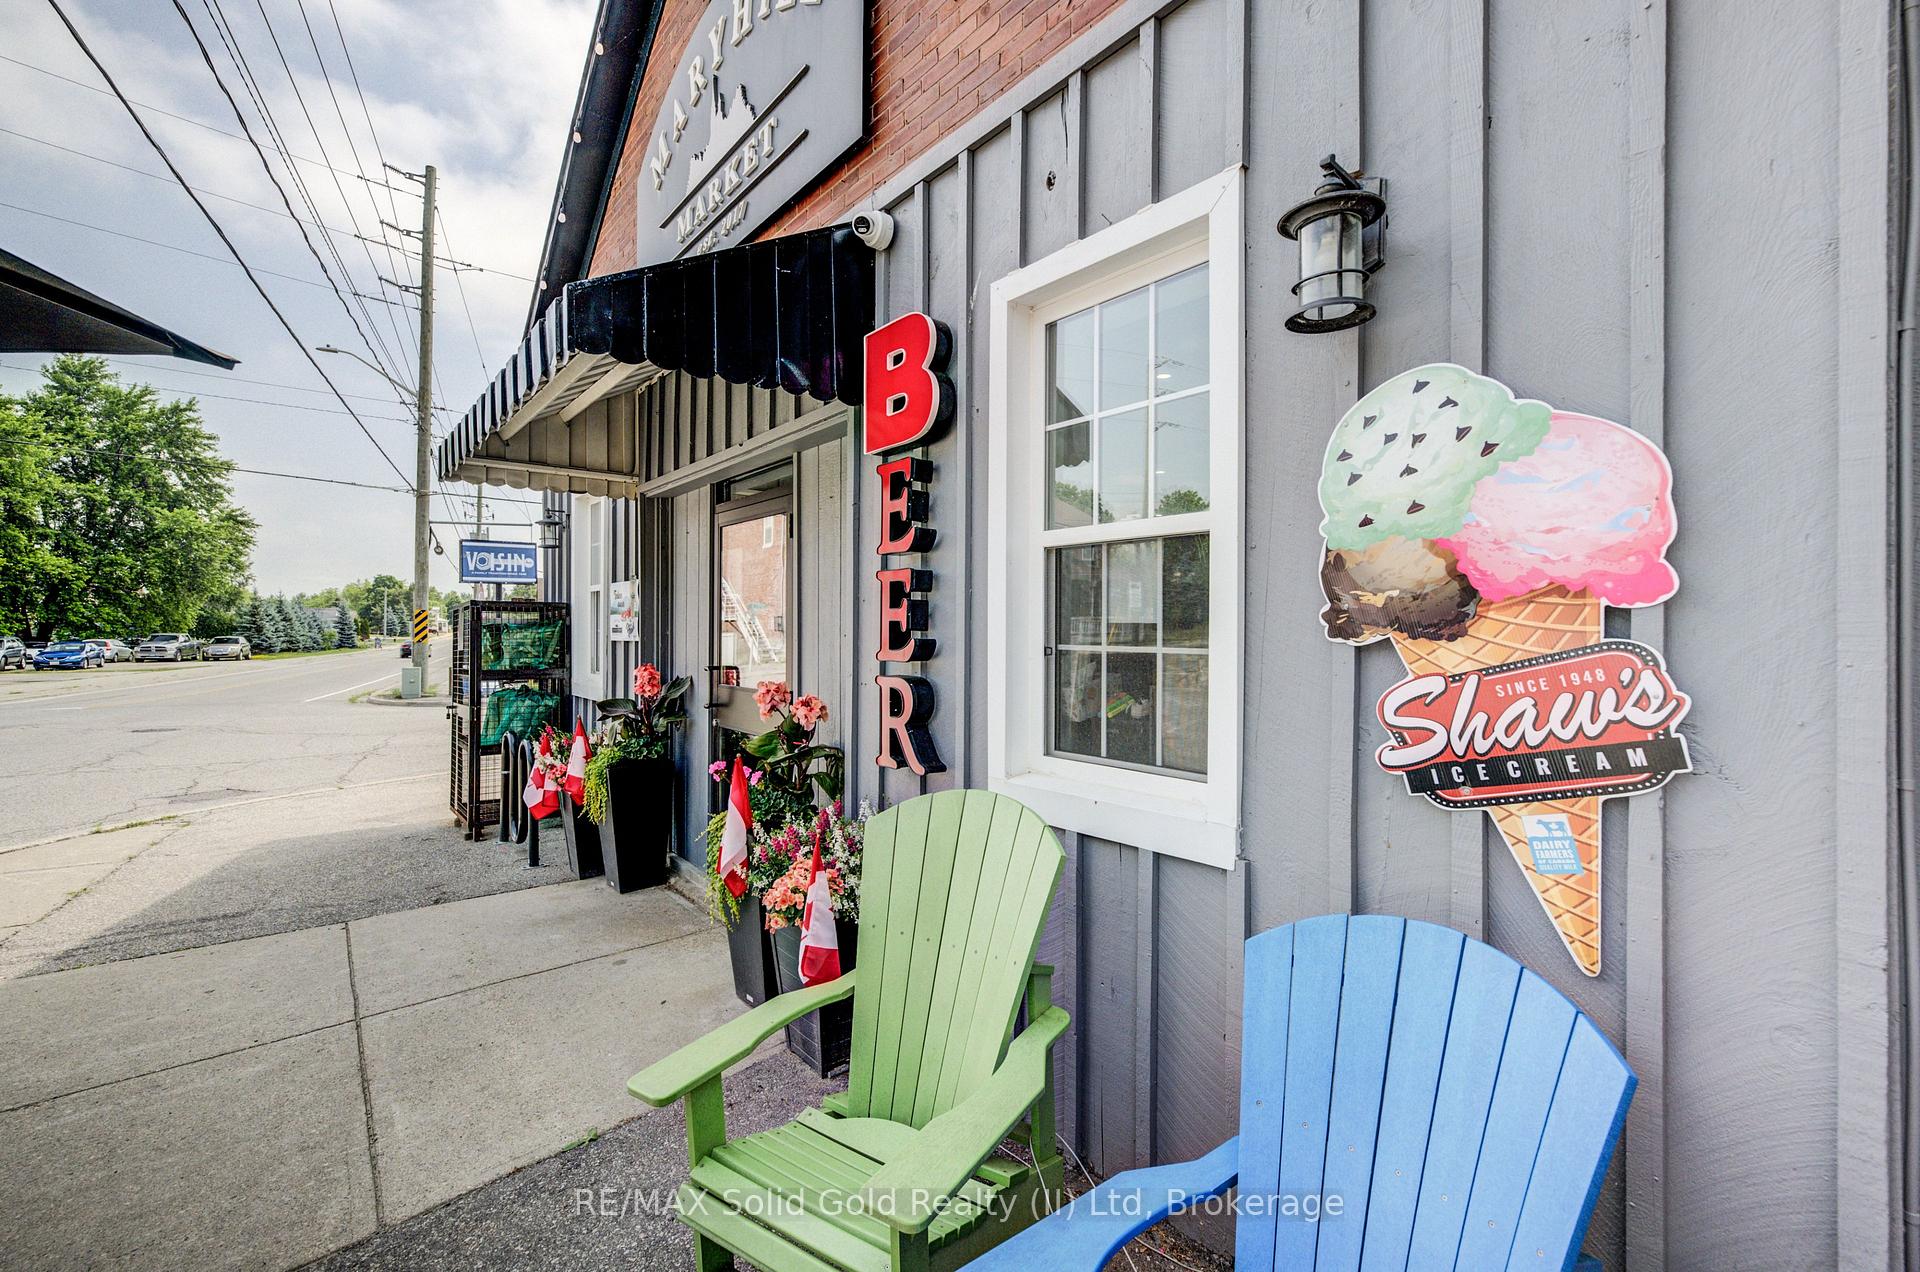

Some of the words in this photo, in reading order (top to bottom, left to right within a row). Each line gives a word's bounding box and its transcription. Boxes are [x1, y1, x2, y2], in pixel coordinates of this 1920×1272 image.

[650, 0, 822, 192] MARYH
[676, 117, 778, 244] MARKET
[465, 551, 527, 572] VOISIN
[864, 311, 942, 778] BEER
[1495, 678, 1549, 697] SINCE
[1559, 668, 1605, 688] 1948
[1380, 667, 1679, 766] Shaw's
[1430, 763, 1489, 785] ICE
[1507, 747, 1648, 778] CREAM
[1532, 840, 1571, 850] DAIRY
[1535, 850, 1575, 859] FARMERS
